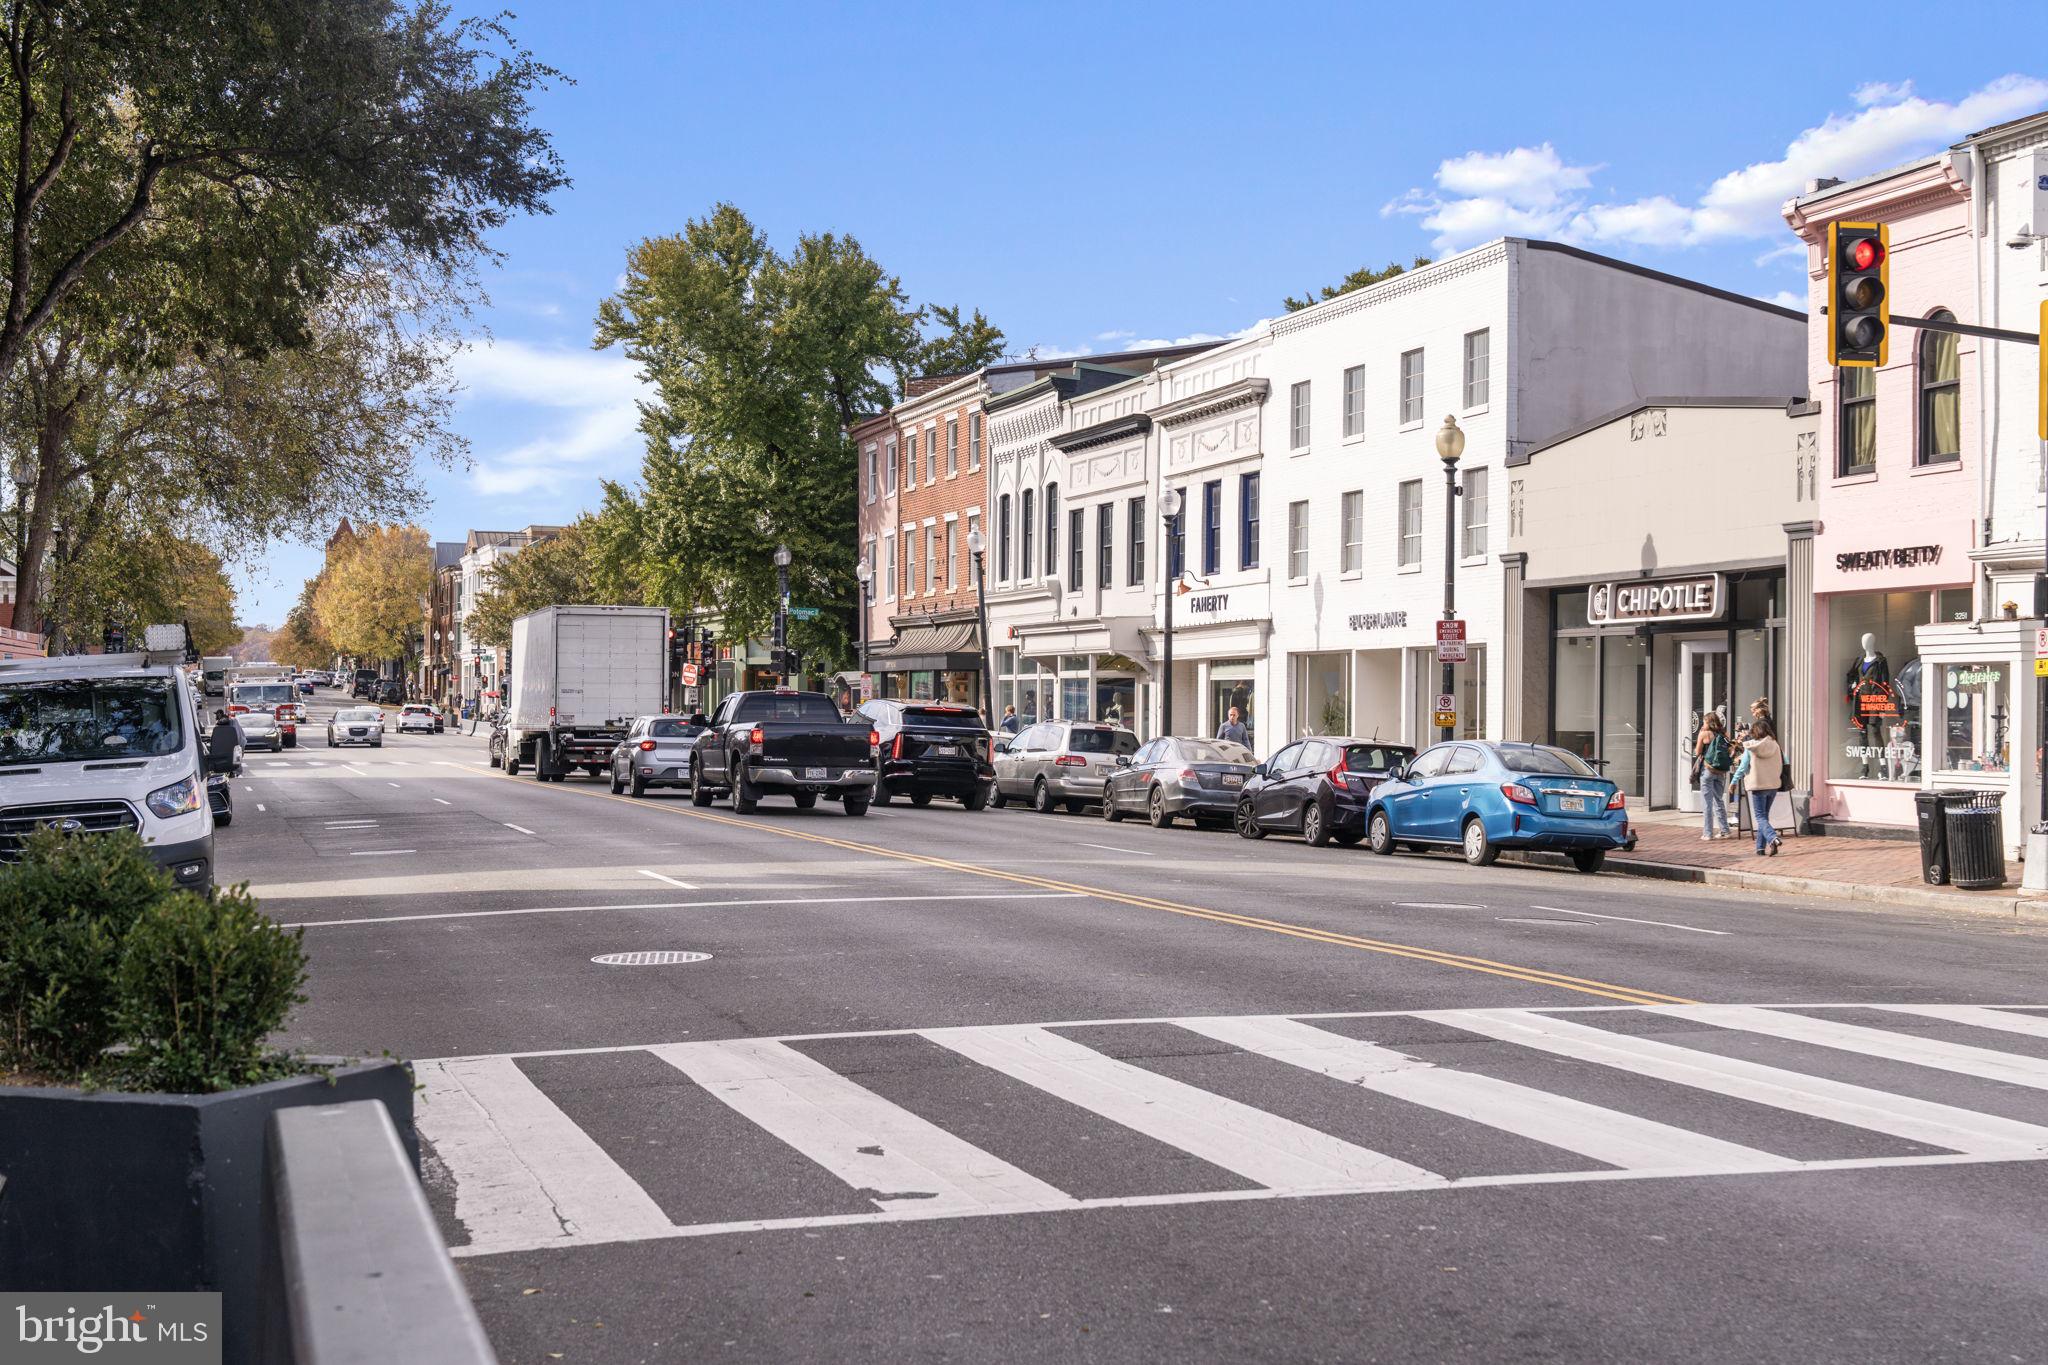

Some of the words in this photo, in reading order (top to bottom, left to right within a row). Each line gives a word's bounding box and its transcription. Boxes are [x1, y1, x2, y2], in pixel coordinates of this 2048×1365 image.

[1836, 549, 1892, 570] SWEATY
[1893, 545, 1940, 565] BETTY
[1190, 594, 1229, 614] FAHERTY
[1617, 583, 1711, 613] CHIPOTLE
[1846, 745, 1884, 758] SWEATY
